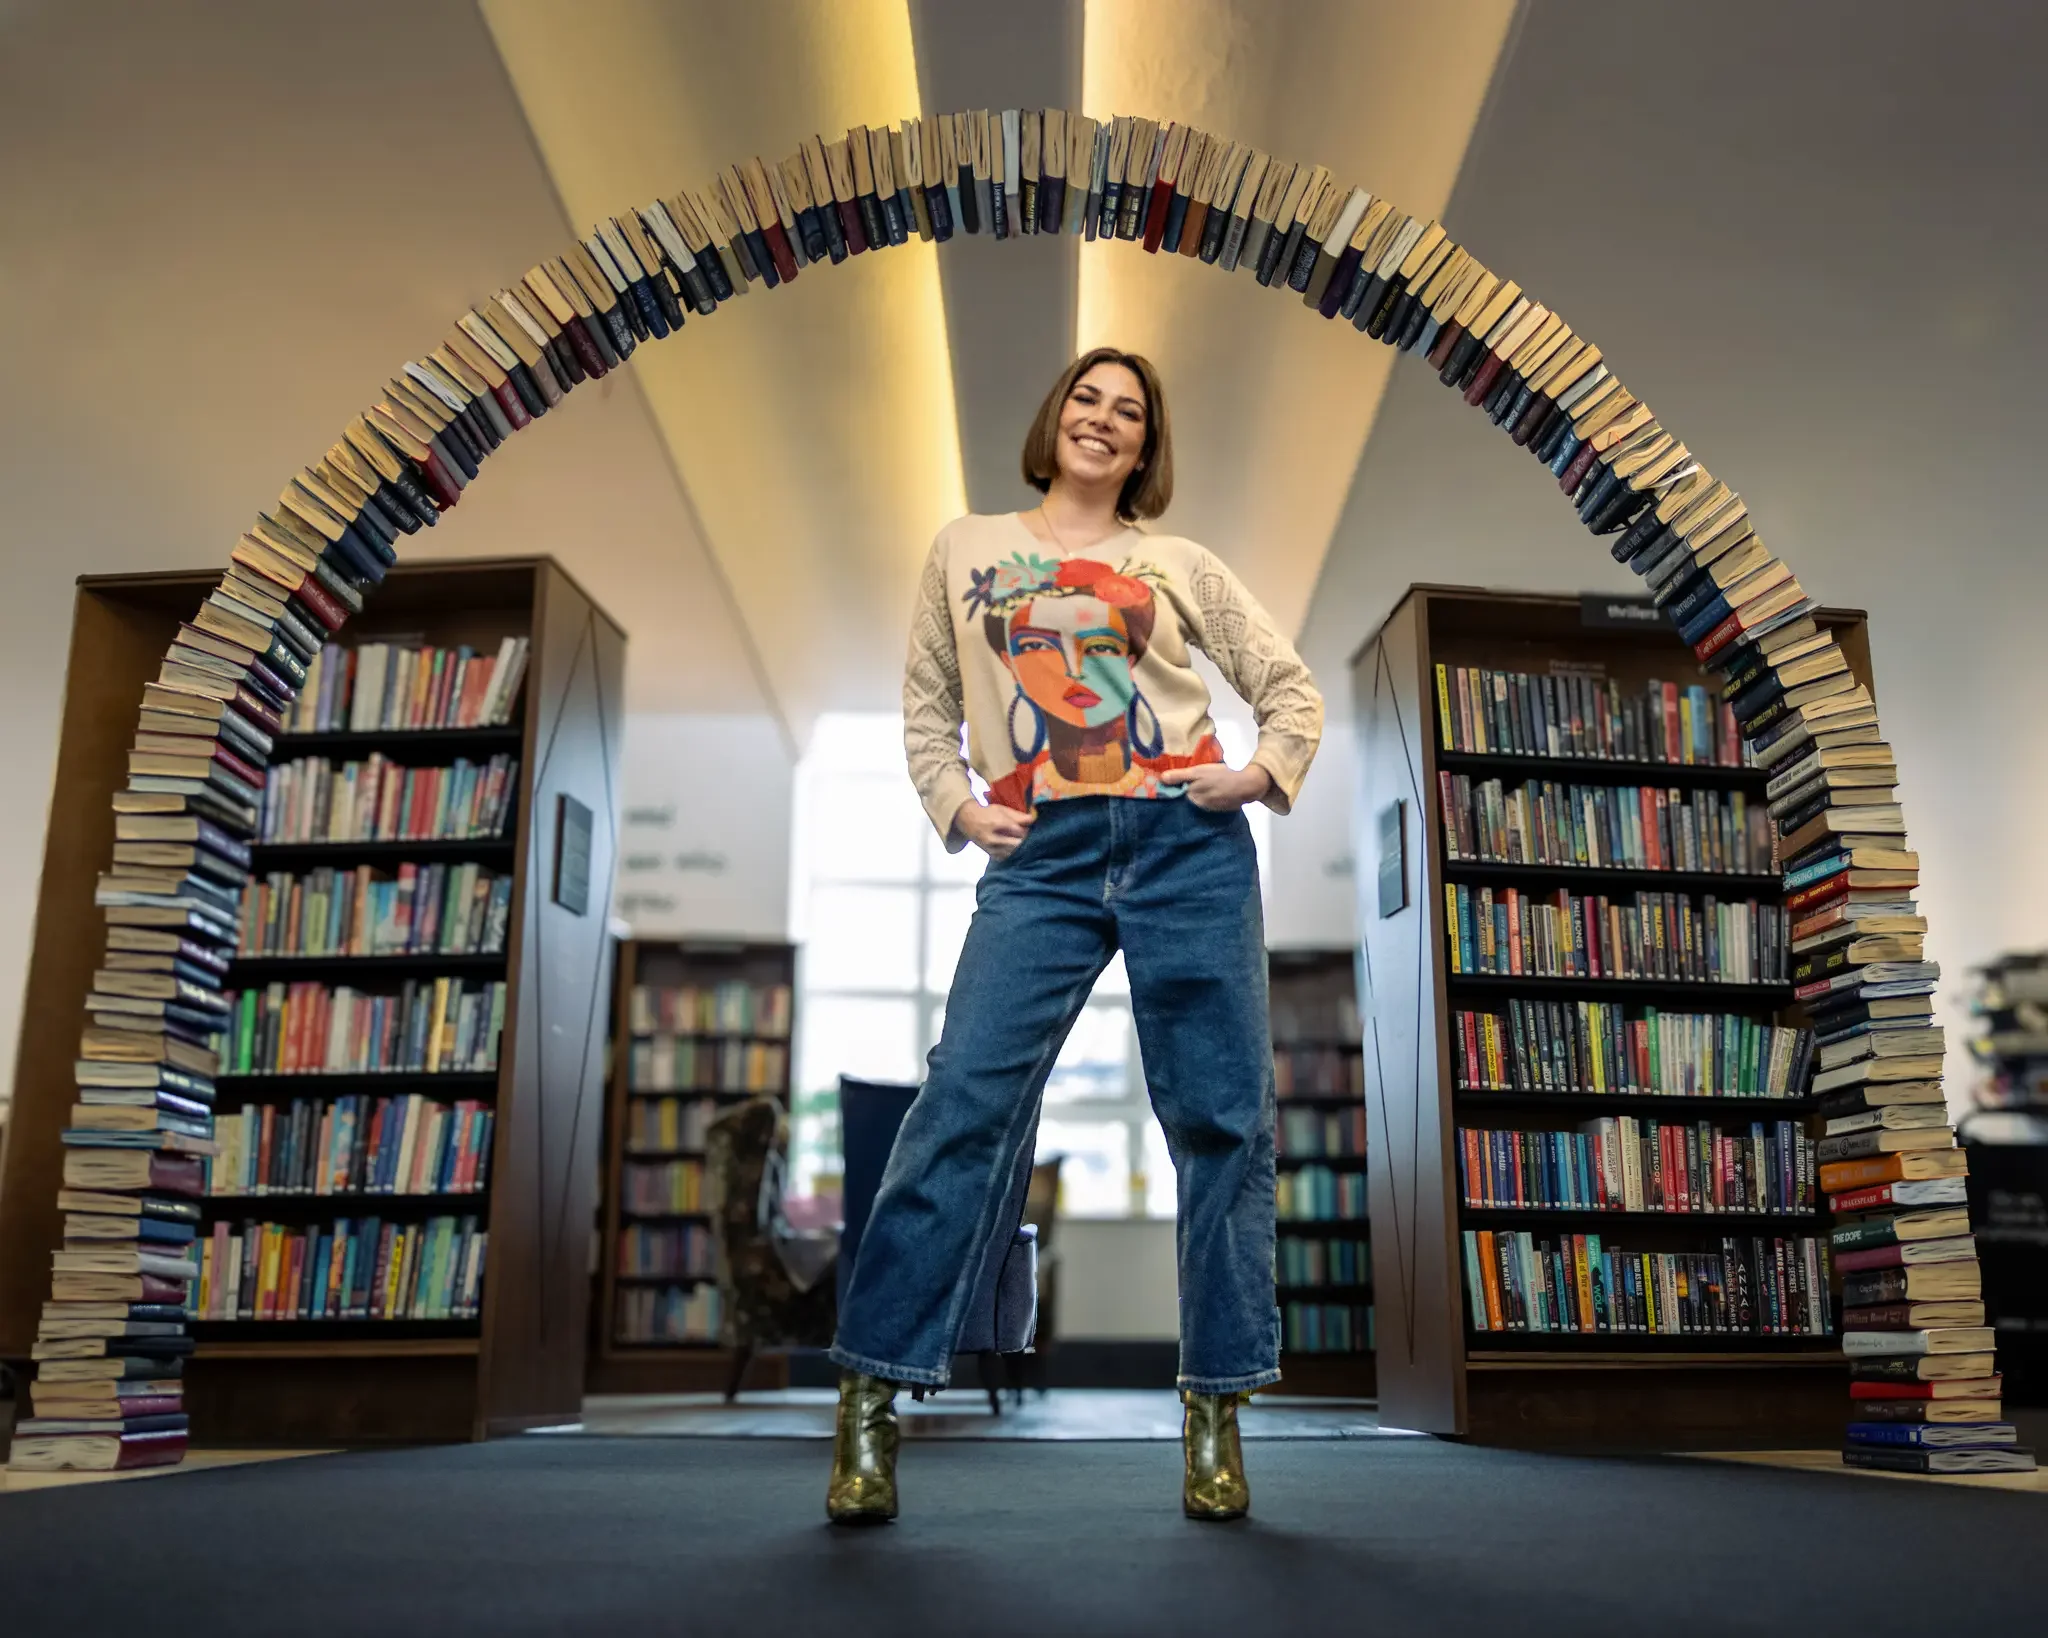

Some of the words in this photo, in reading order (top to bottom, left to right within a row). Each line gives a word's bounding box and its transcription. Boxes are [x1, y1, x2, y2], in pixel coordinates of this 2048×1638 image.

[1607, 605, 1659, 620] thrillers
[1671, 592, 1699, 617] INTRIGO
[1575, 920, 1583, 949] BONES
[1794, 963, 1814, 979] RUN
[1498, 1151, 1506, 1170] MAID
[1796, 1136, 1806, 1182] BILLINGHAM
[1806, 1150, 1814, 1185] BILLINGHAM
[1839, 1193, 1877, 1209] SHAKESPEARE
[1832, 1232, 1845, 1244] THE
[1844, 1229, 1862, 1241] DOPE
[1563, 1240, 1571, 1265] SWEET
[1776, 1247, 1784, 1272] HAVOC
[1785, 1243, 1794, 1265] DEADLY
[1502, 1267, 1511, 1290] WATER
[1635, 1281, 1643, 1296] NAILS
[1726, 1263, 1734, 1292] MURDER
[1769, 1270, 1777, 1295] UNDER
[1788, 1266, 1797, 1293] SECRETS
[1594, 1284, 1603, 1313] WOLF
[1729, 1294, 1735, 1302] IN
